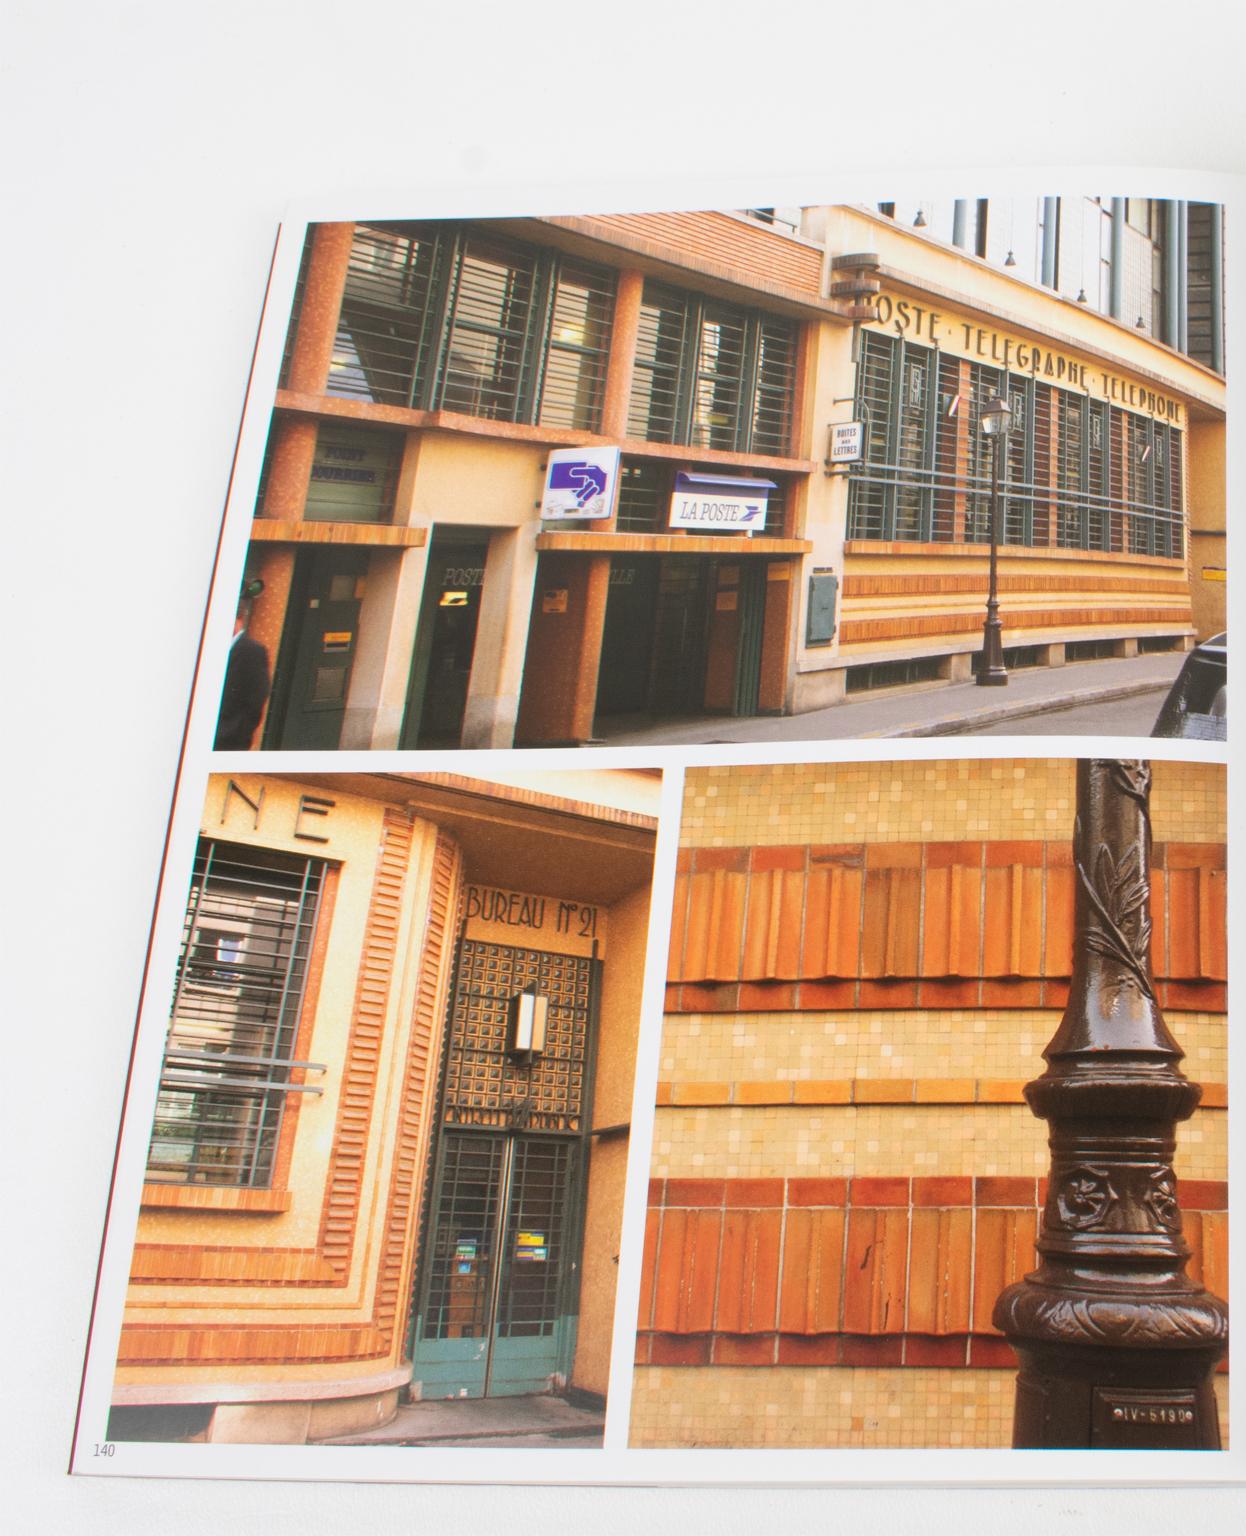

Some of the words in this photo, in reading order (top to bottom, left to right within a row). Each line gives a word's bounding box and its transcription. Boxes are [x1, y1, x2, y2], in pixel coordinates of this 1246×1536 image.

[866, 295, 940, 346] OSTE
[680, 501, 697, 519] LA
[700, 503, 740, 522] POSTE
[465, 886, 546, 929] BUREAU
[93, 1443, 116, 1458] 140
